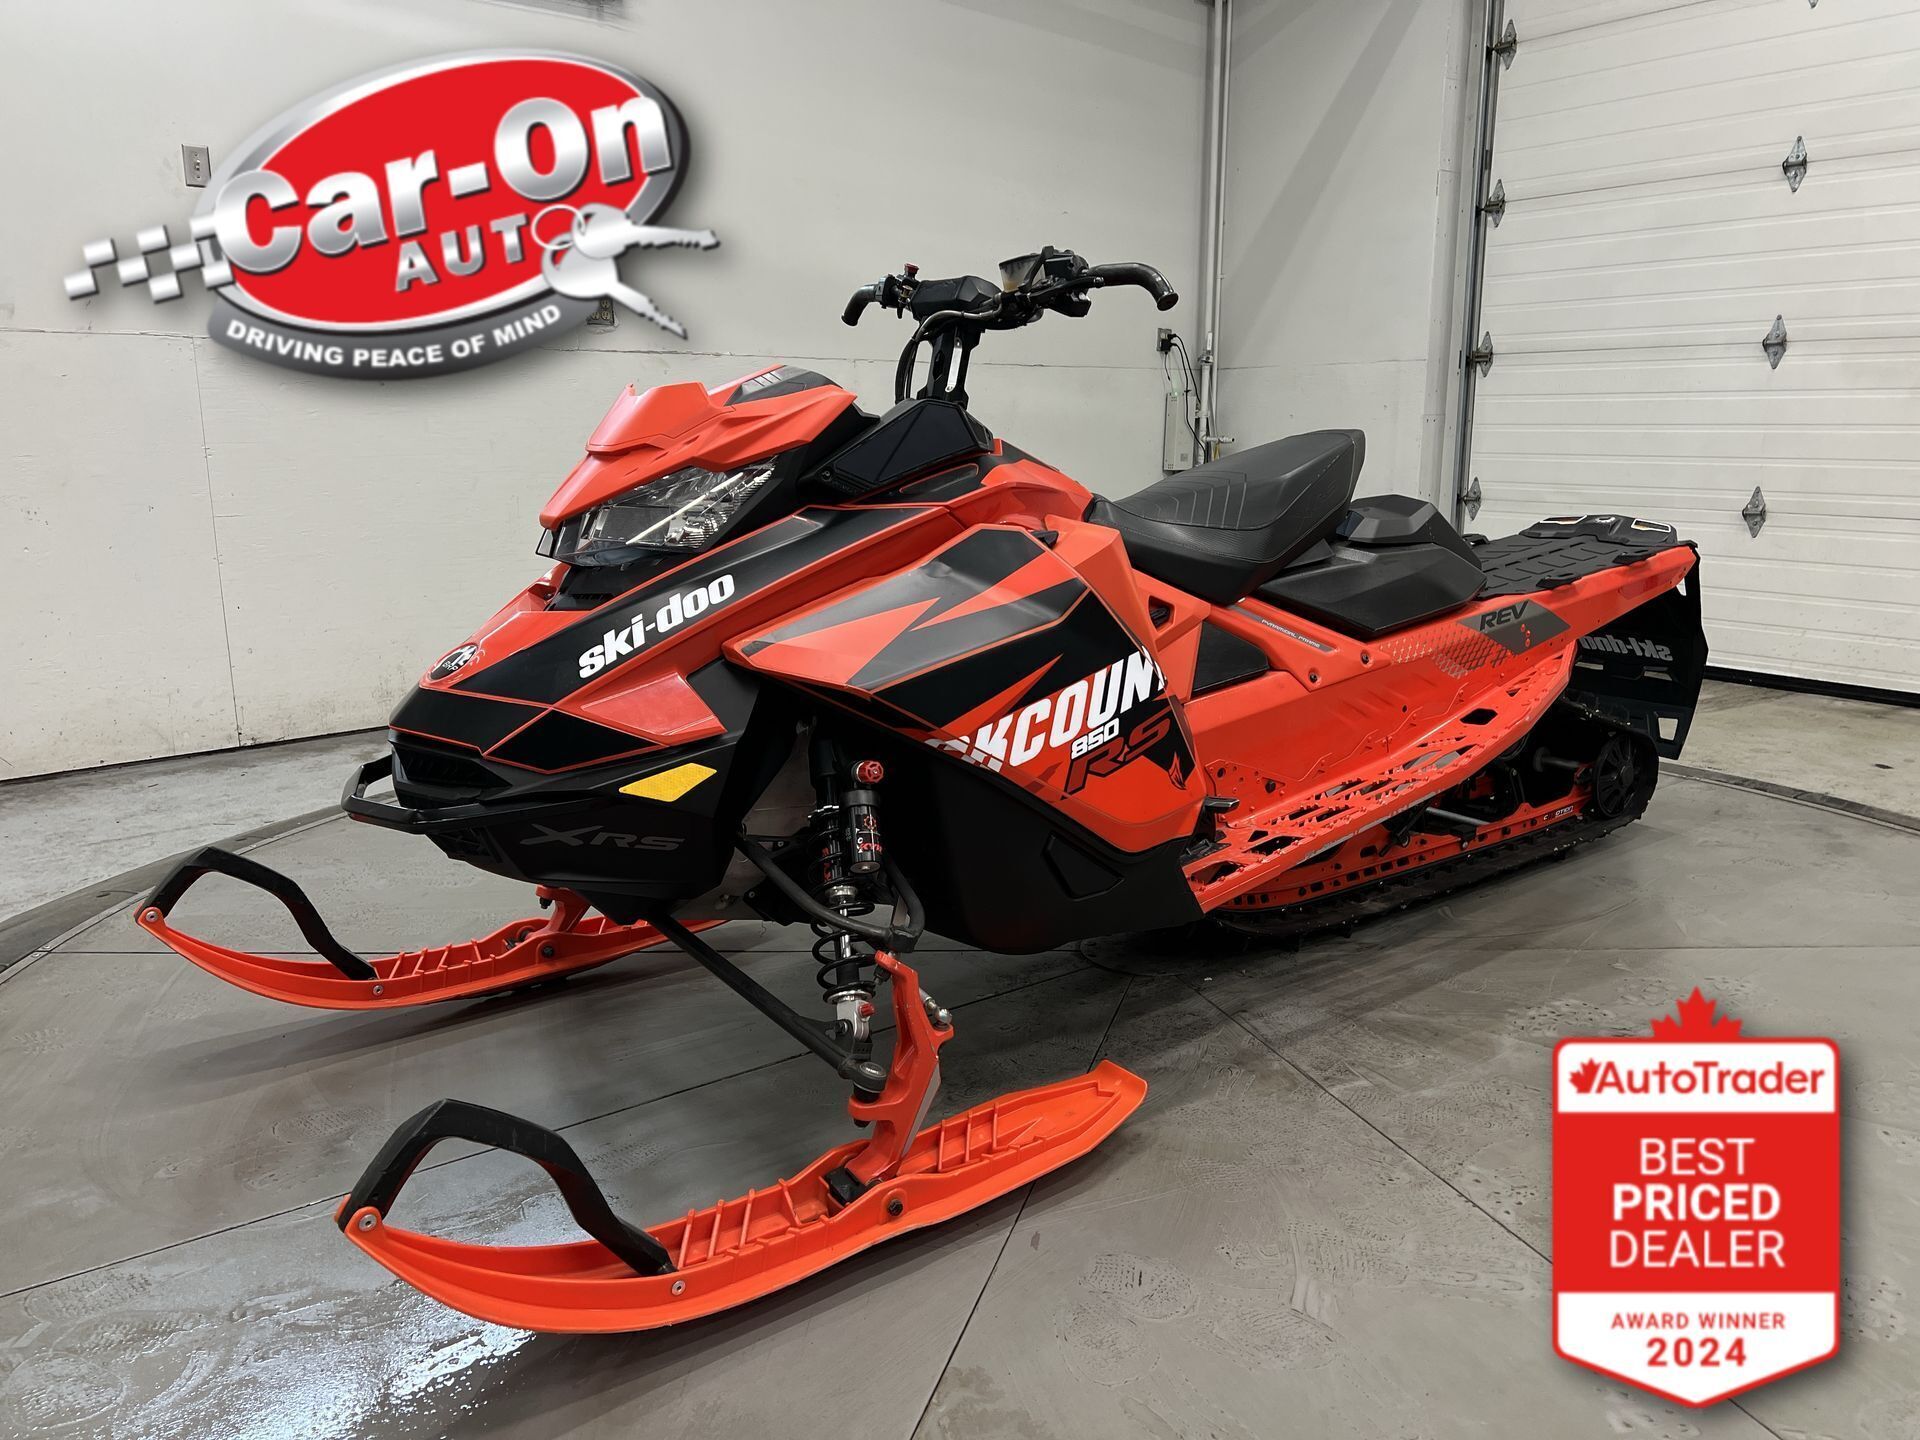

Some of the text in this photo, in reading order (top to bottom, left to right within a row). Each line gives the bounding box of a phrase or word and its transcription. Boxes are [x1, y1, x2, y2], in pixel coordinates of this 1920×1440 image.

[578, 574, 735, 679] ski-doo
[1480, 600, 1530, 631] REV
[1063, 716, 1172, 798] RS
[1070, 717, 1120, 761] 850
[519, 823, 686, 851] XRS
